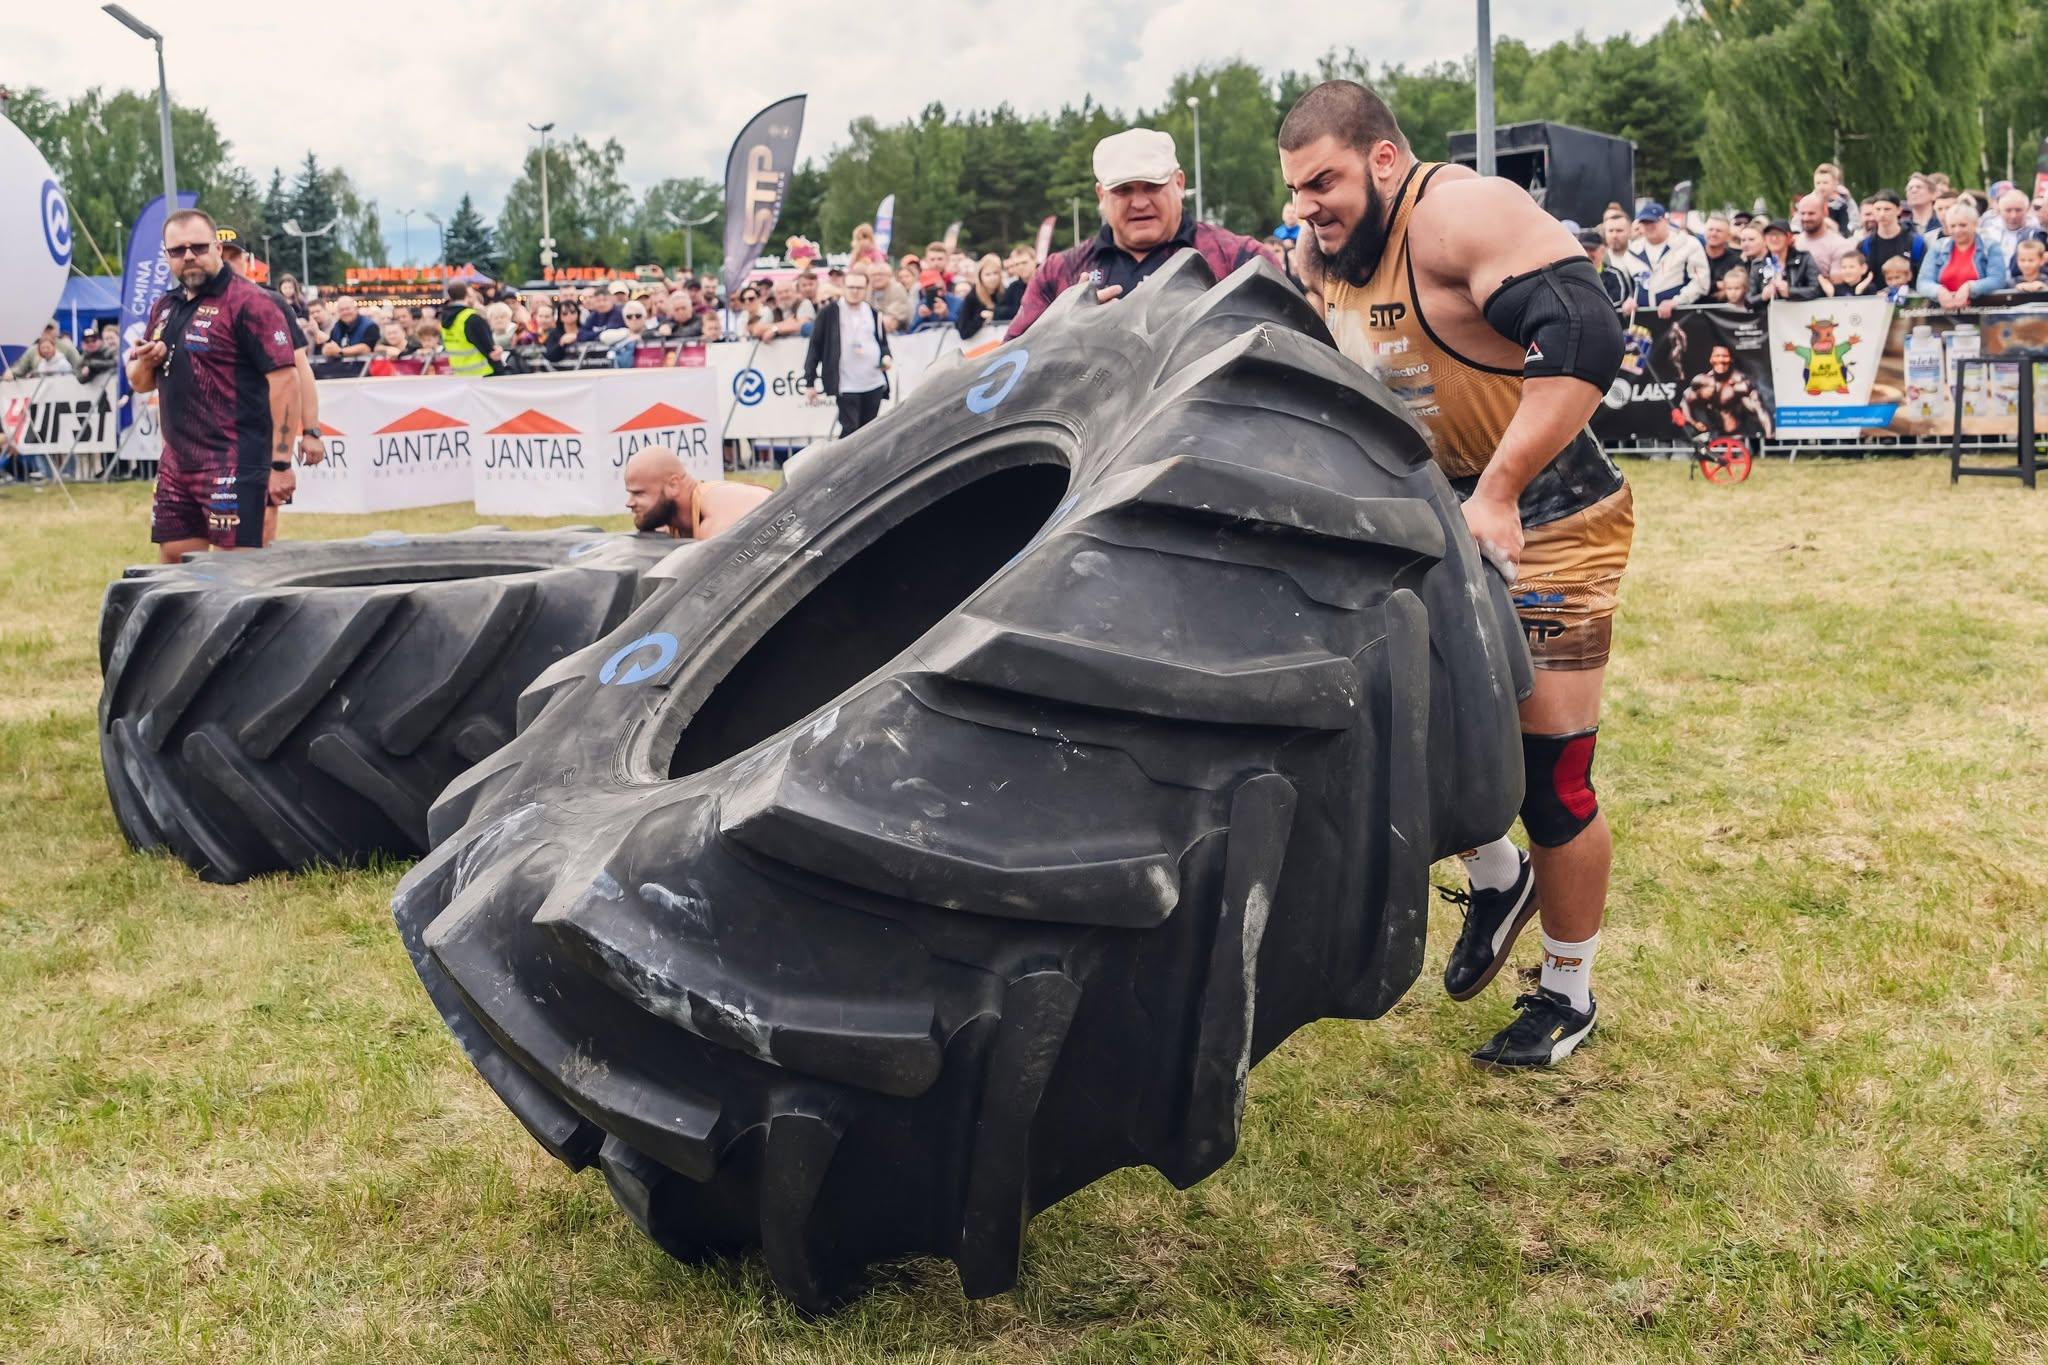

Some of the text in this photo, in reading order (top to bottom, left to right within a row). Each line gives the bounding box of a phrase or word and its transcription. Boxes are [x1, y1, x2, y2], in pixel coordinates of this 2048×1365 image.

[743, 145, 779, 246] STP
[1369, 302, 1406, 327] STP
[1631, 382, 1677, 402] LABS
[373, 430, 472, 467] JANTAR
[485, 438, 585, 469] JANTAR
[209, 514, 241, 527] STP
